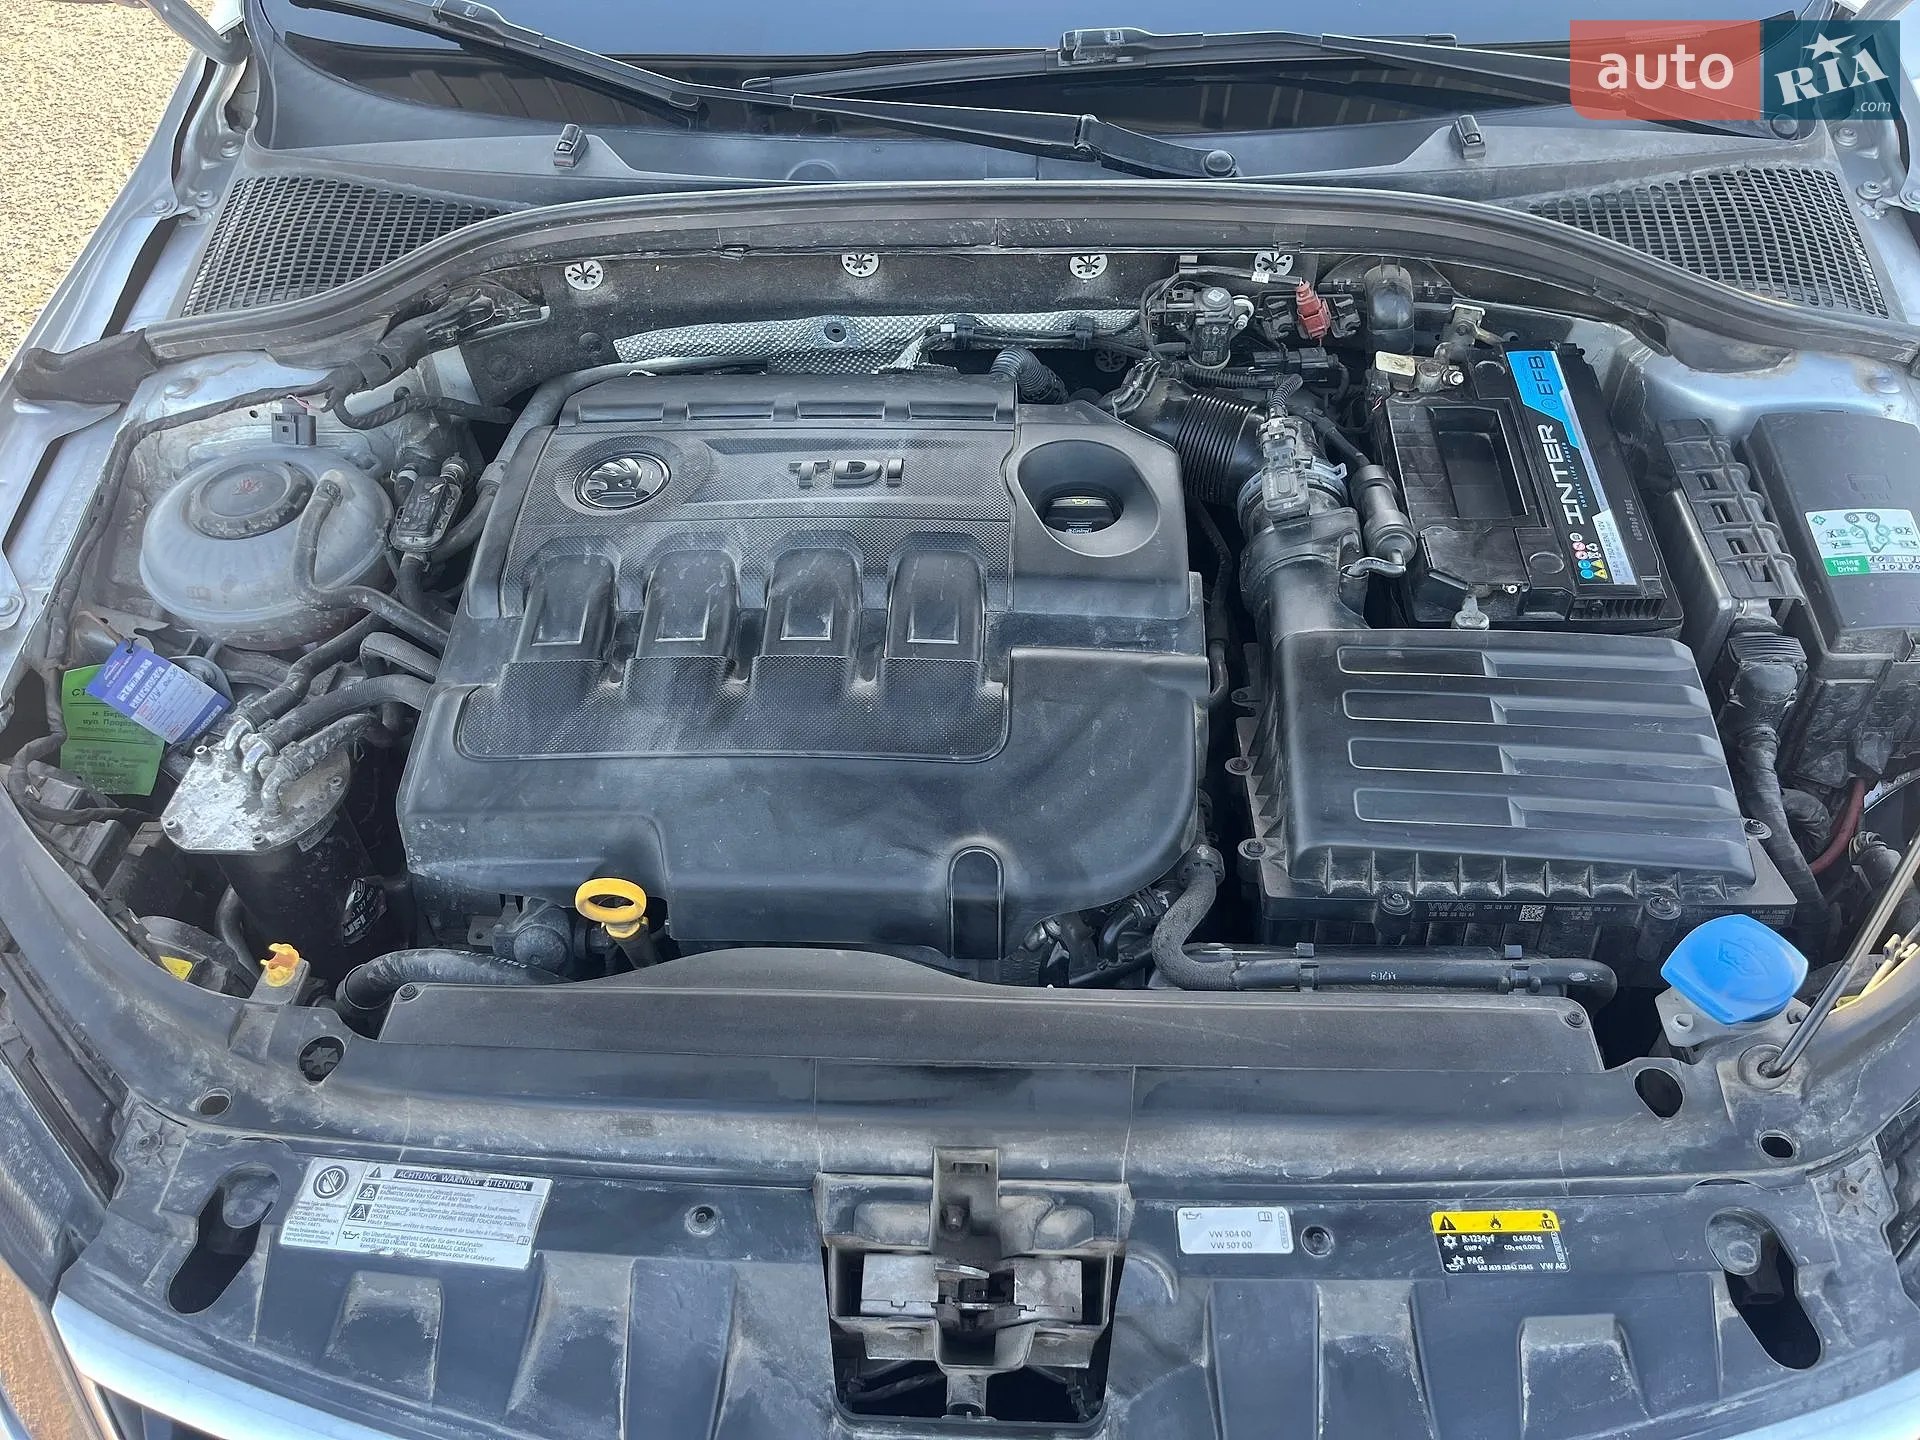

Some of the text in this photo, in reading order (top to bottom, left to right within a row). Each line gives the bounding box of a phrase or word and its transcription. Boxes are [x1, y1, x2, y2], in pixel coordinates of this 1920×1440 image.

[1528, 356, 1554, 395] EFB
[788, 459, 904, 488] TDI
[1537, 424, 1584, 525] INTER
[1832, 559, 1860, 567] Timing
[1838, 565, 1859, 573] Drive
[397, 1170, 437, 1180] ACHTUNG
[482, 1178, 527, 1189] ATTENTION
[1462, 1235, 1495, 1244] R-1234yf
